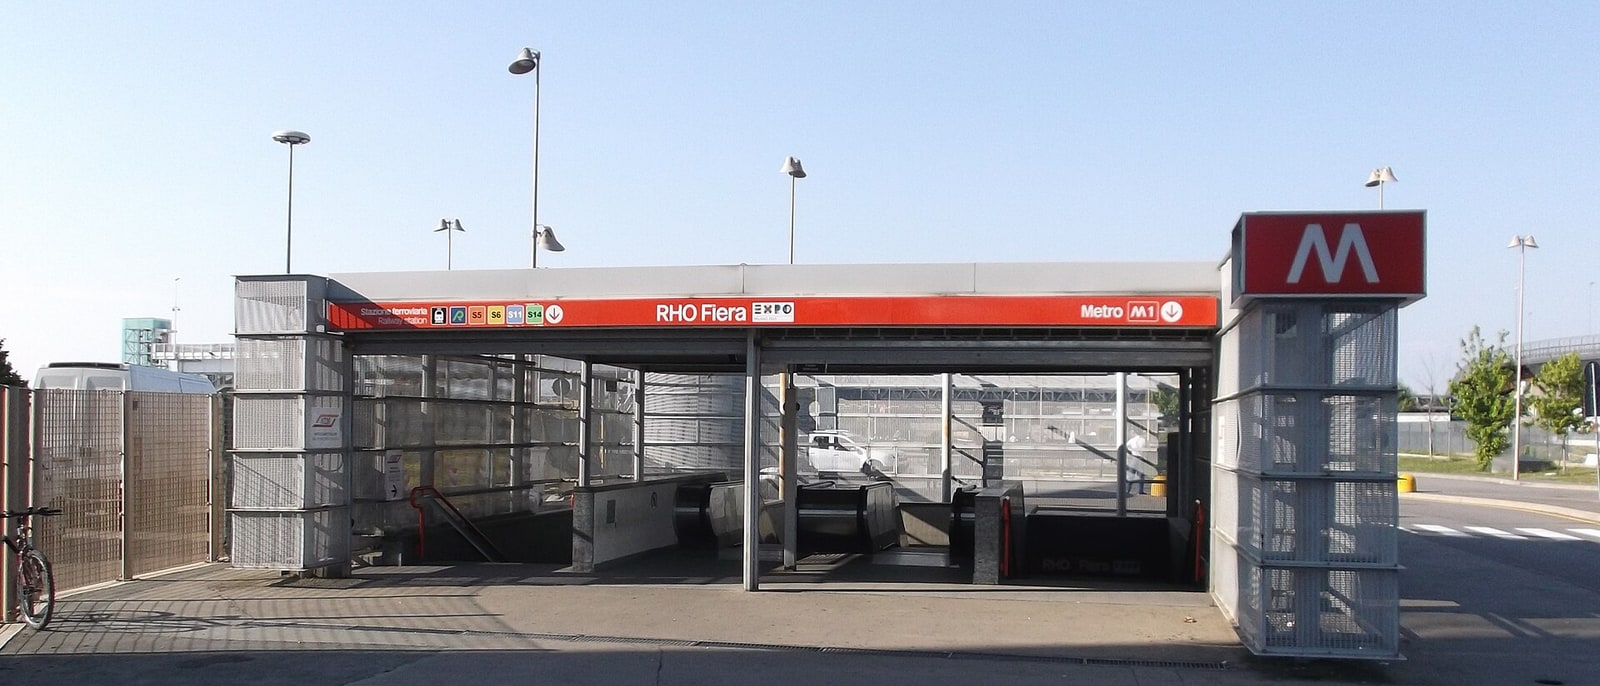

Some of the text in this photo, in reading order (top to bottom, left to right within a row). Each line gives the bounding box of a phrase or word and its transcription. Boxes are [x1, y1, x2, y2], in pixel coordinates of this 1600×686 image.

[1286, 223, 1380, 284] M
[360, 306, 429, 316] Stazione ferroviaria
[507, 310, 522, 319] S11
[527, 310, 542, 319] S14
[656, 304, 747, 322] RHO Fiera
[754, 304, 792, 315] EXPO
[1081, 304, 1124, 318] Metro
[471, 310, 483, 320] S5
[490, 310, 502, 320] S6
[379, 316, 429, 326] Railway station
